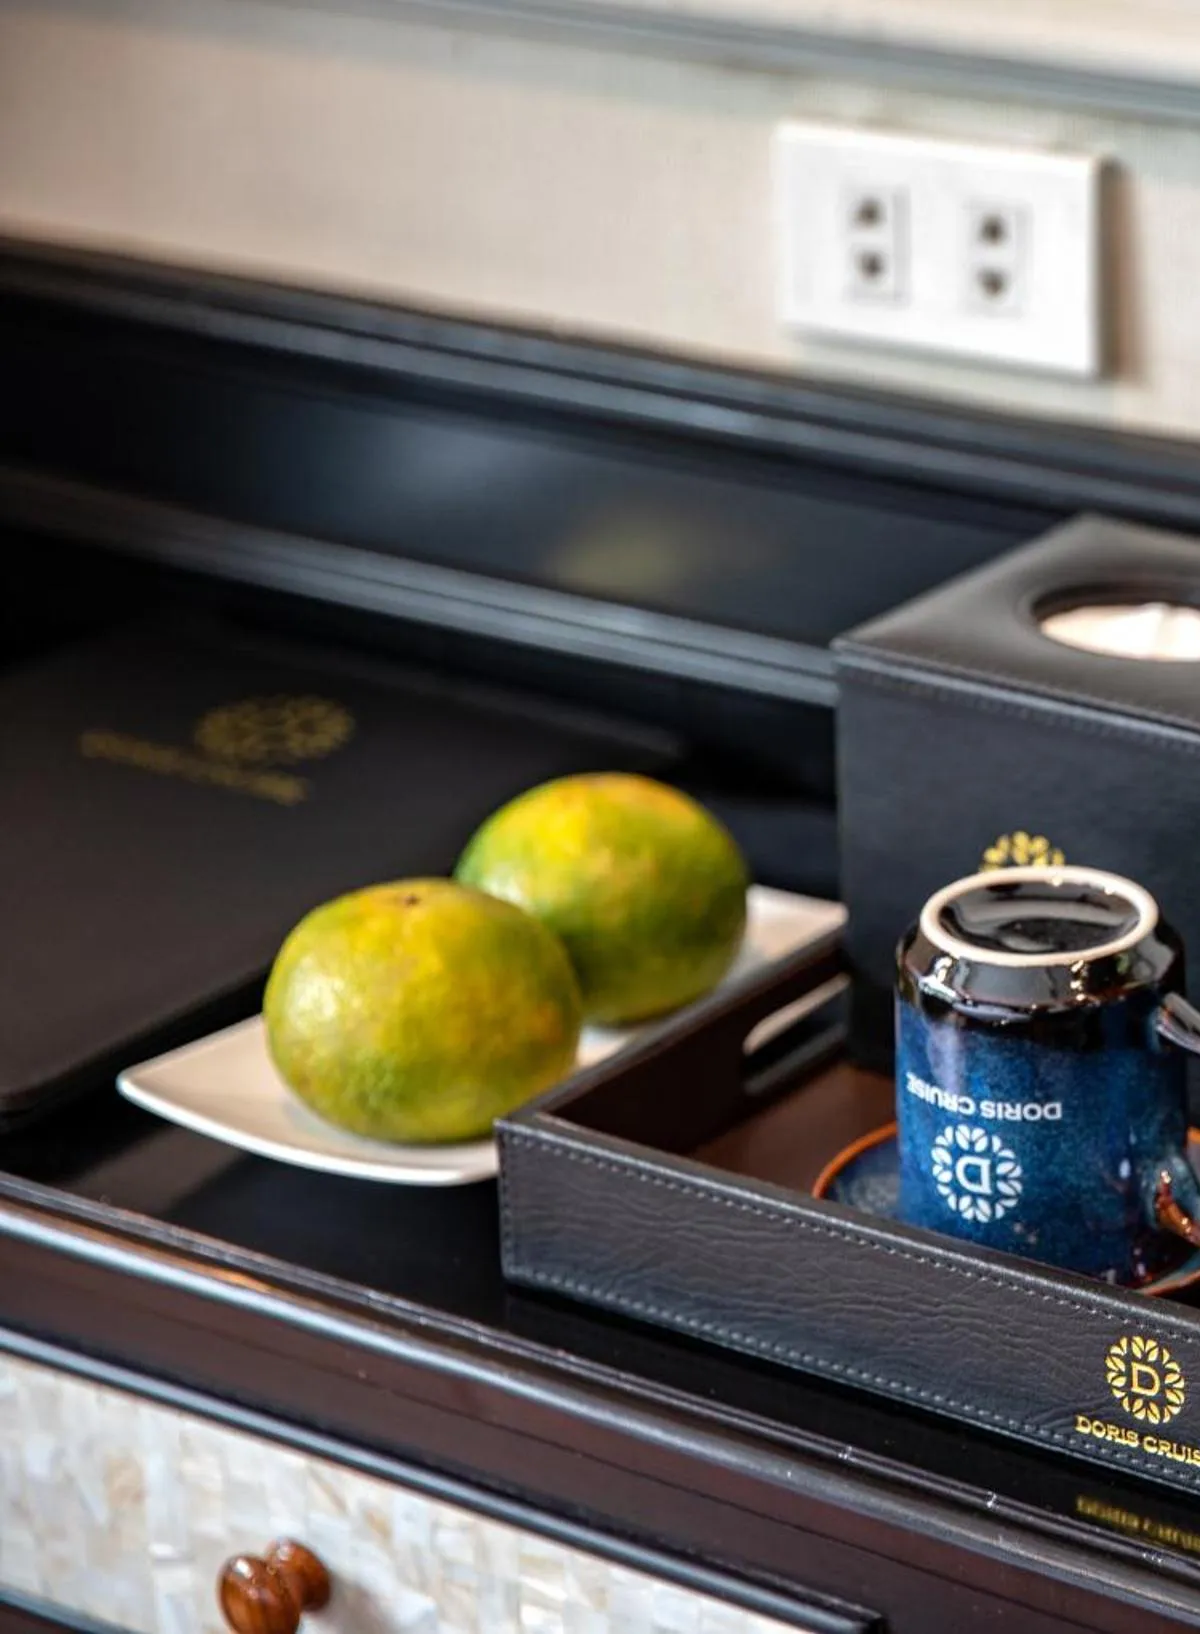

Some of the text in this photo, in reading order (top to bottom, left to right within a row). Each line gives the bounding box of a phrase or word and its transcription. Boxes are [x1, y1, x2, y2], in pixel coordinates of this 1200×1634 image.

[906, 1071, 1062, 1121] DORIS CRUISE
[955, 1155, 992, 1195] D
[1131, 1361, 1160, 1396] D
[1075, 1414, 1139, 1447] DORIS
